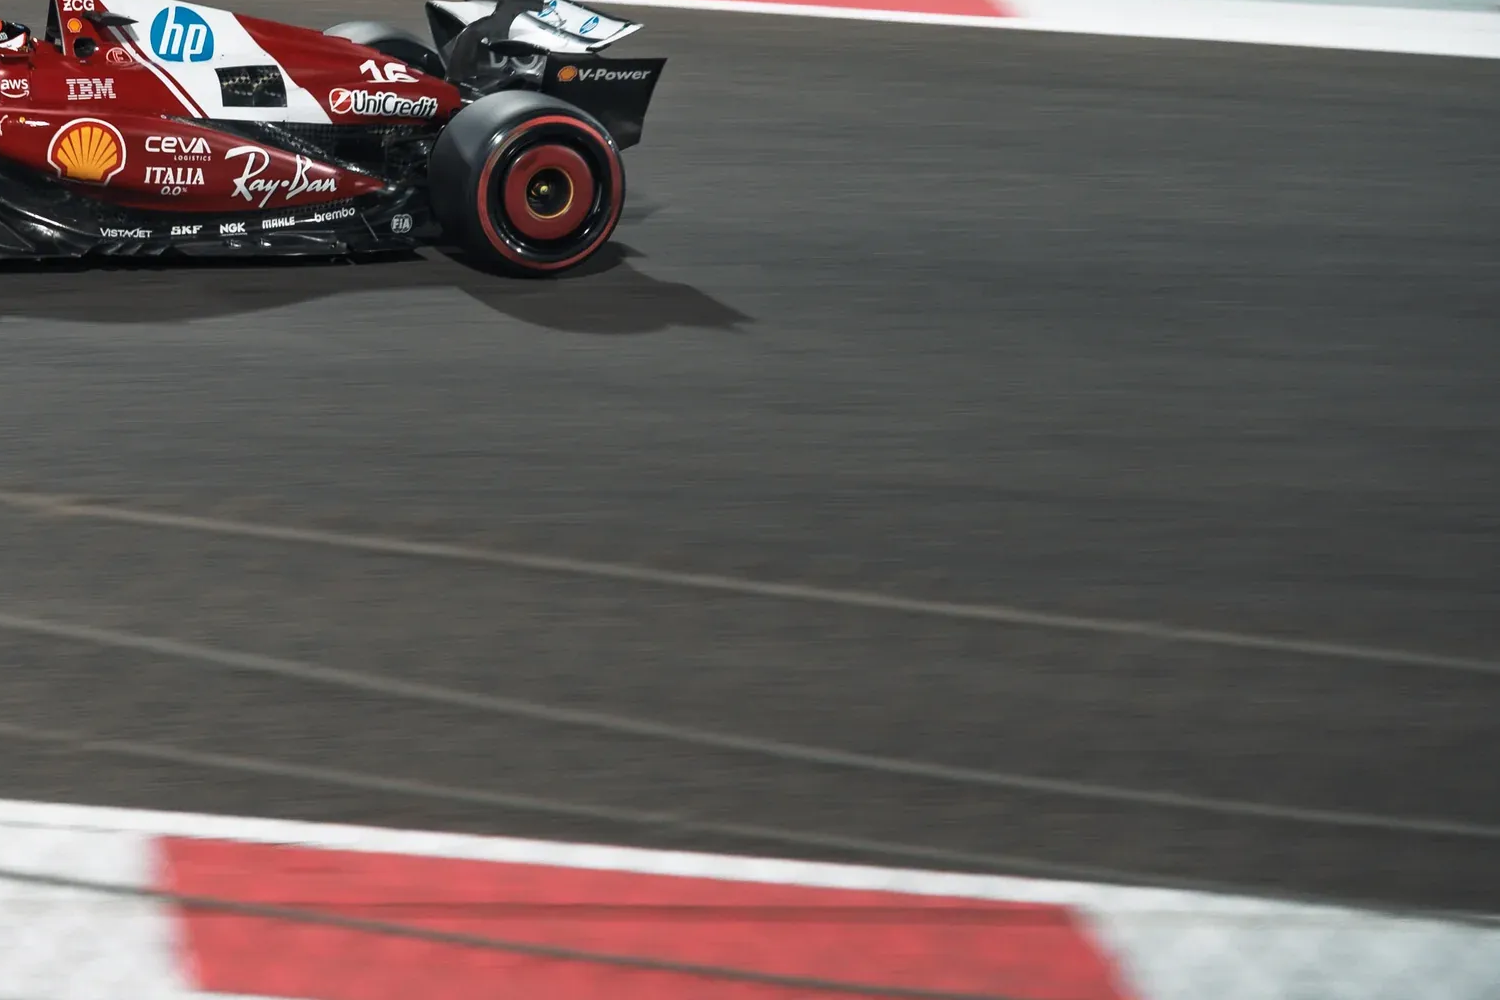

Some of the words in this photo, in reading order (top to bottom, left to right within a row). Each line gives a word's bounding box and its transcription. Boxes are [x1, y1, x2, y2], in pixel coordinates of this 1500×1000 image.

[158, 6, 208, 62] hp
[360, 59, 420, 83] 16
[578, 68, 652, 82] V-Power
[1, 78, 29, 91] aws
[66, 78, 117, 101] IBM
[352, 90, 438, 118] UniCredit
[144, 166, 205, 185] ITALIA
[261, 216, 296, 229] MAHLE
[314, 207, 356, 223] brembo
[170, 224, 203, 236] SKF
[219, 221, 246, 234] NGK
